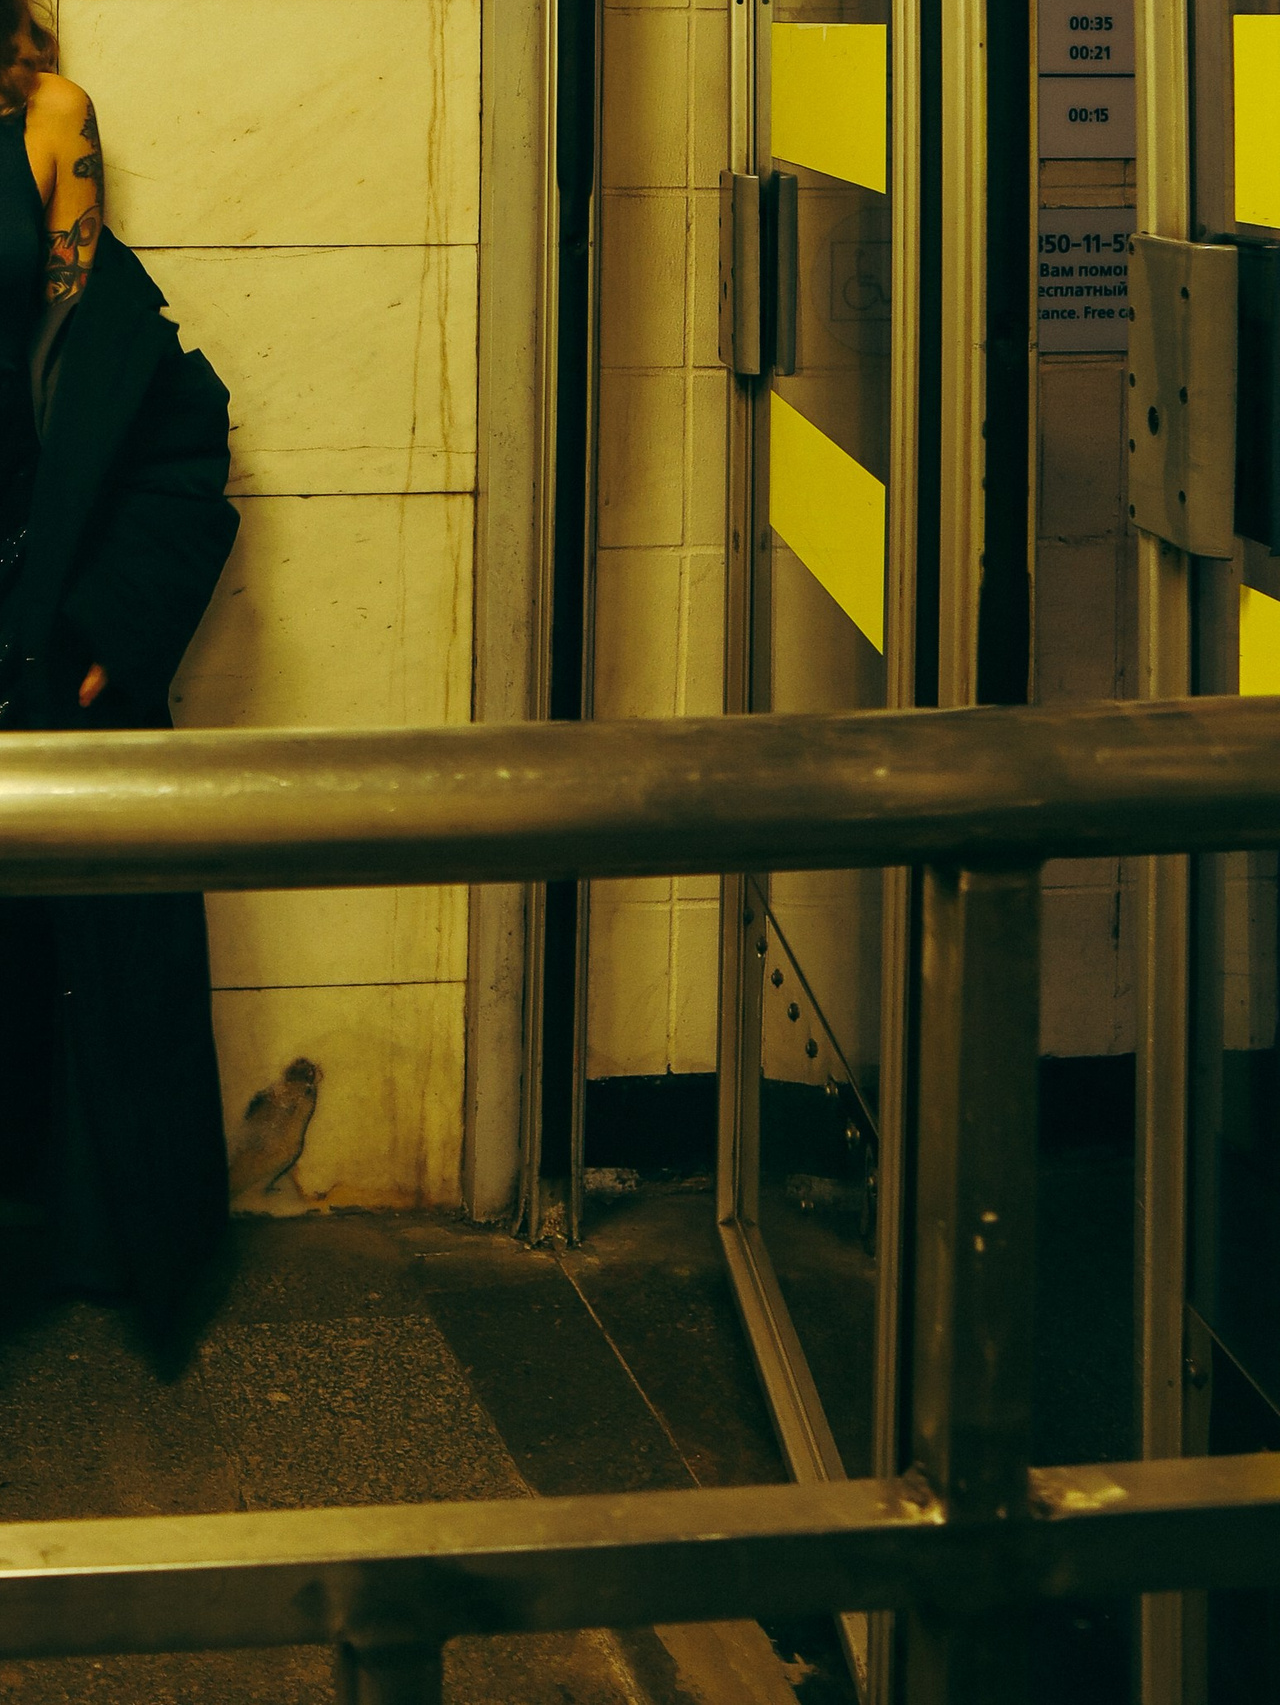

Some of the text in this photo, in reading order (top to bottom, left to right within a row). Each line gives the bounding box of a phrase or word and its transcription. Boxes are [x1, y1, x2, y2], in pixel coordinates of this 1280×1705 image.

[1069, 16, 1113, 31] 00:35
[1069, 45, 1111, 60] 00:21
[1068, 108, 1109, 123] 00:15
[1040, 263, 1074, 278] Вам
[1083, 306, 1115, 320] Free
